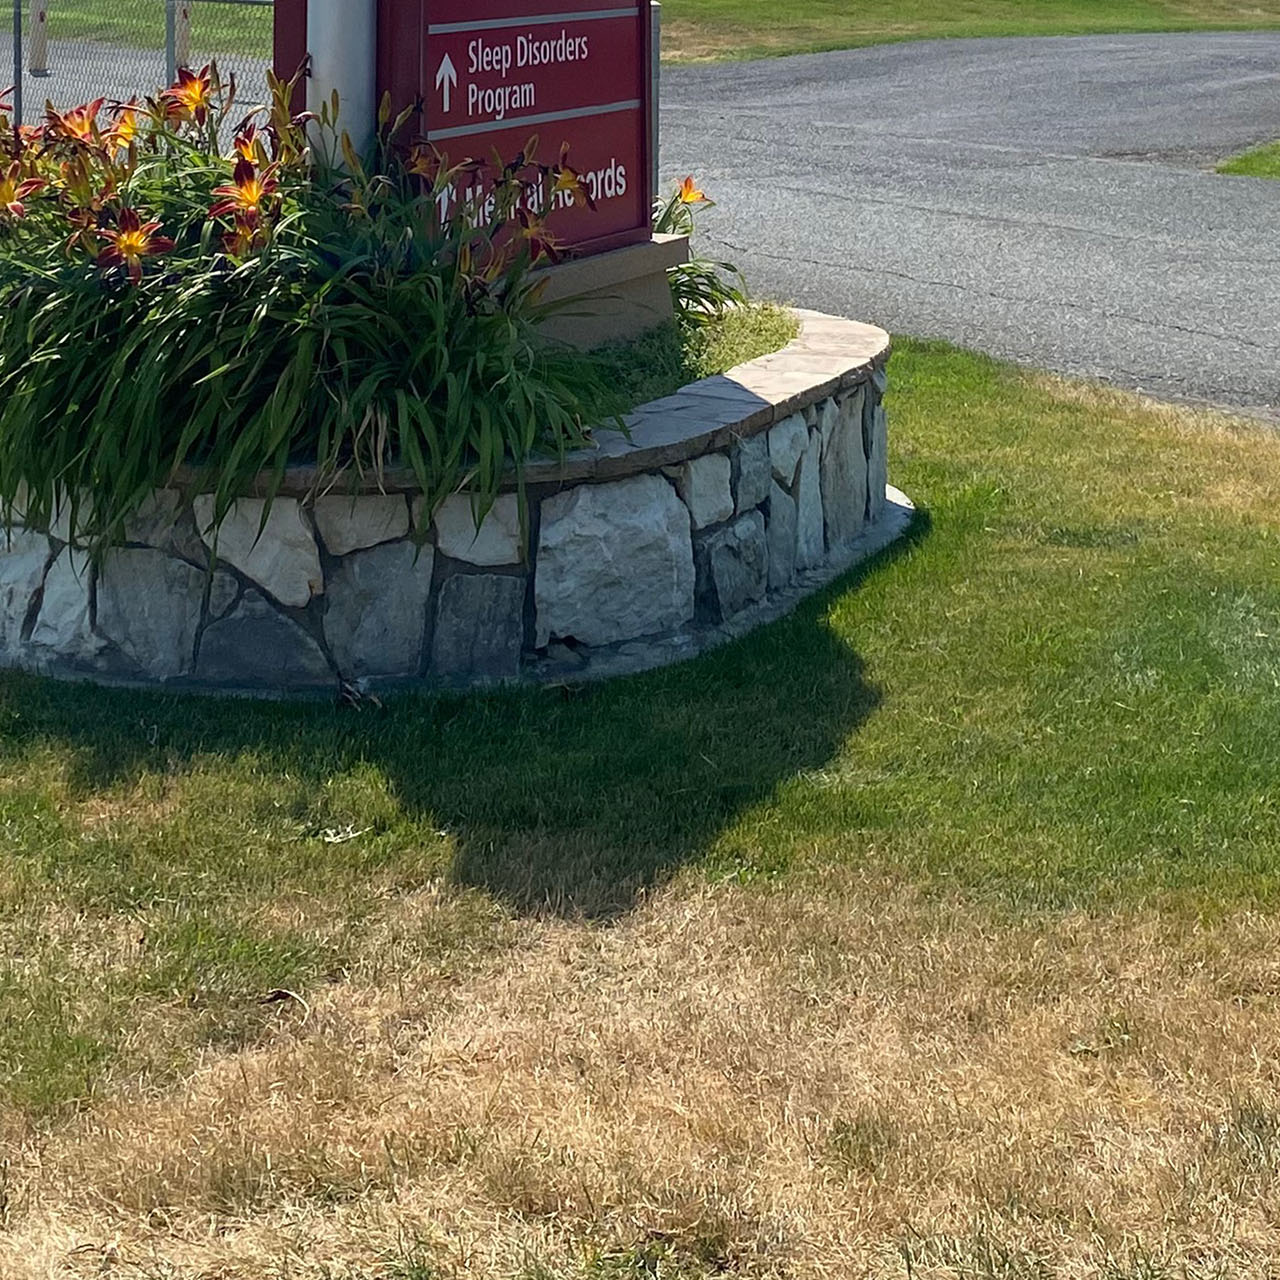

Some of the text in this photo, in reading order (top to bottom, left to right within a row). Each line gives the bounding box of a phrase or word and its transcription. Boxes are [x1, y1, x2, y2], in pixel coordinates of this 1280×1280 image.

[468, 29, 589, 78] Sleep Disorders
[468, 82, 536, 120] Program
[465, 158, 627, 228] Meal eords
